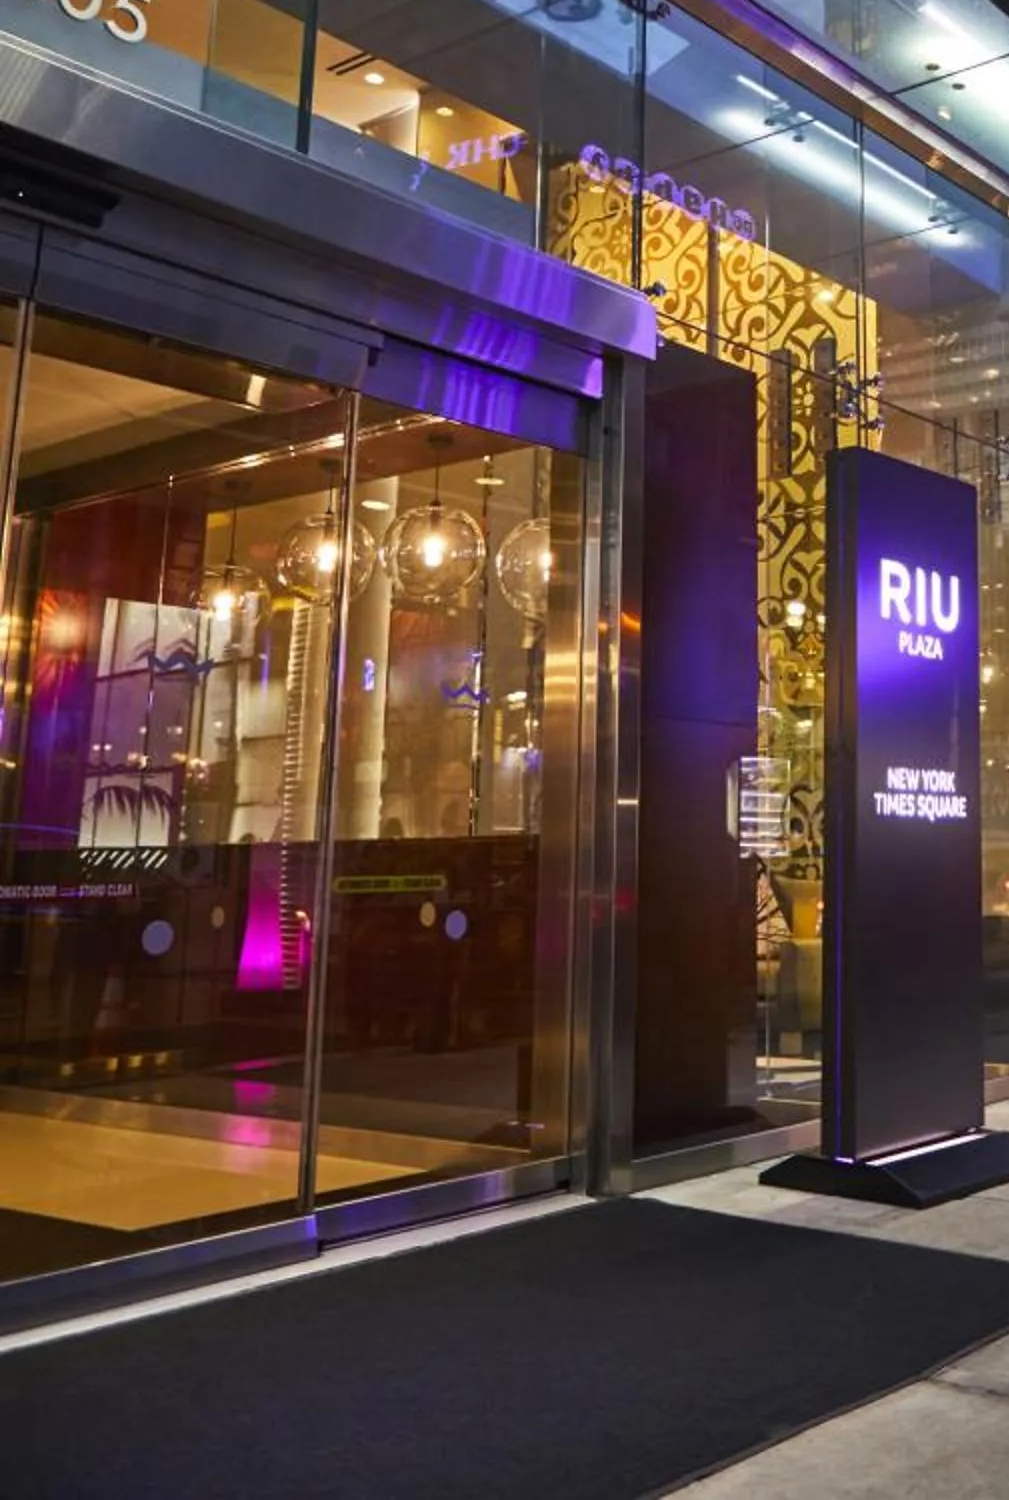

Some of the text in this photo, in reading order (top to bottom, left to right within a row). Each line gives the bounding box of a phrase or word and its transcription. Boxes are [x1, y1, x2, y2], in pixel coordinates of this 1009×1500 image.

[880, 557, 960, 633] RIU
[898, 630, 944, 661] PLAZA
[887, 766, 956, 793] NEW YORK
[873, 792, 967, 823] TIMES SQUARE
